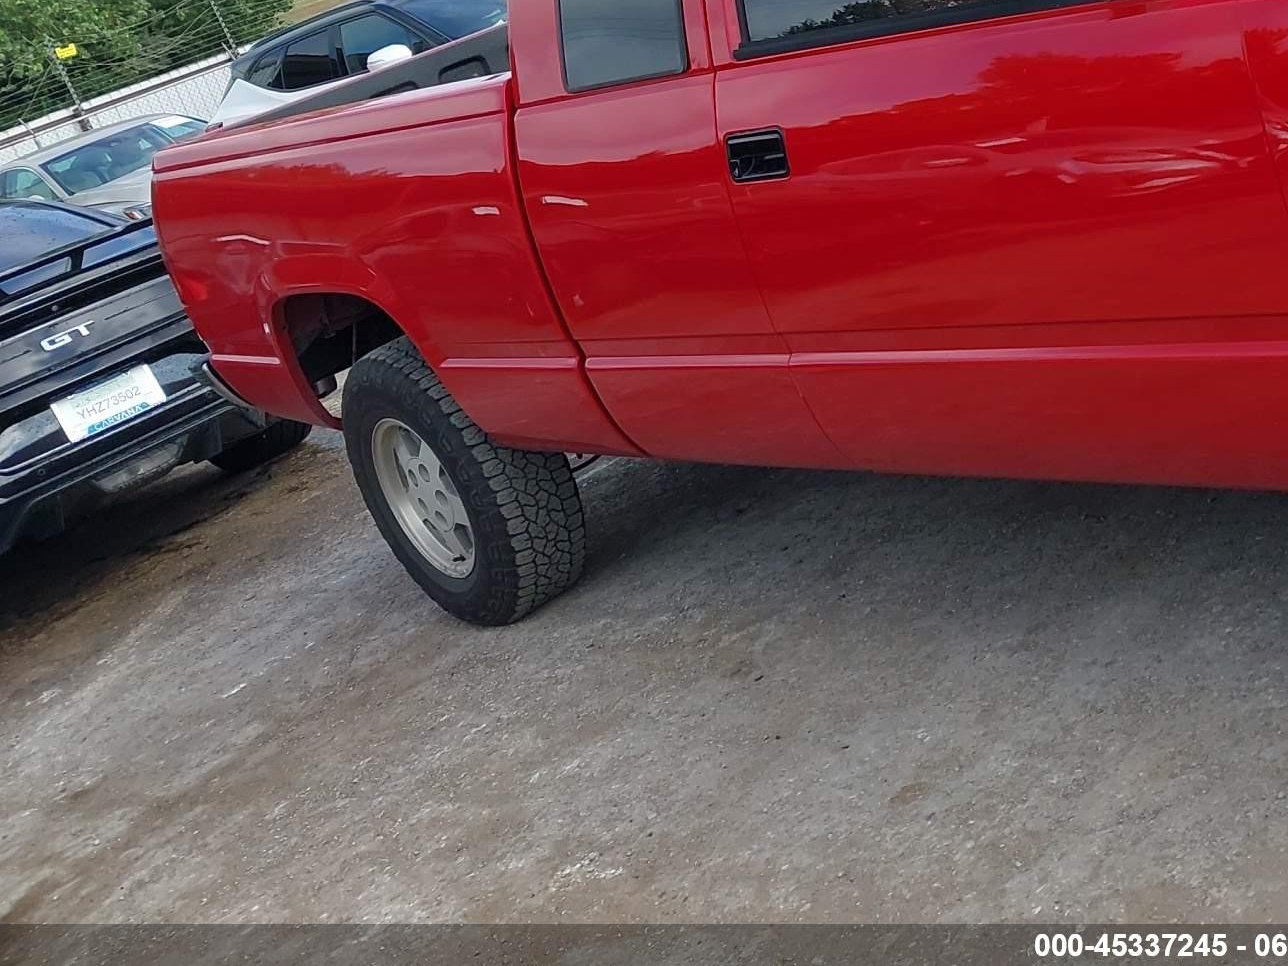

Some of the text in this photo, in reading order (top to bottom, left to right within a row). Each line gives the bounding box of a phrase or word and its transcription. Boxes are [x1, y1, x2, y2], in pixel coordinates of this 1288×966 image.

[40, 320, 95, 351] GT
[76, 386, 141, 420] YHZ73502
[97, 406, 141, 429] CARVANA
